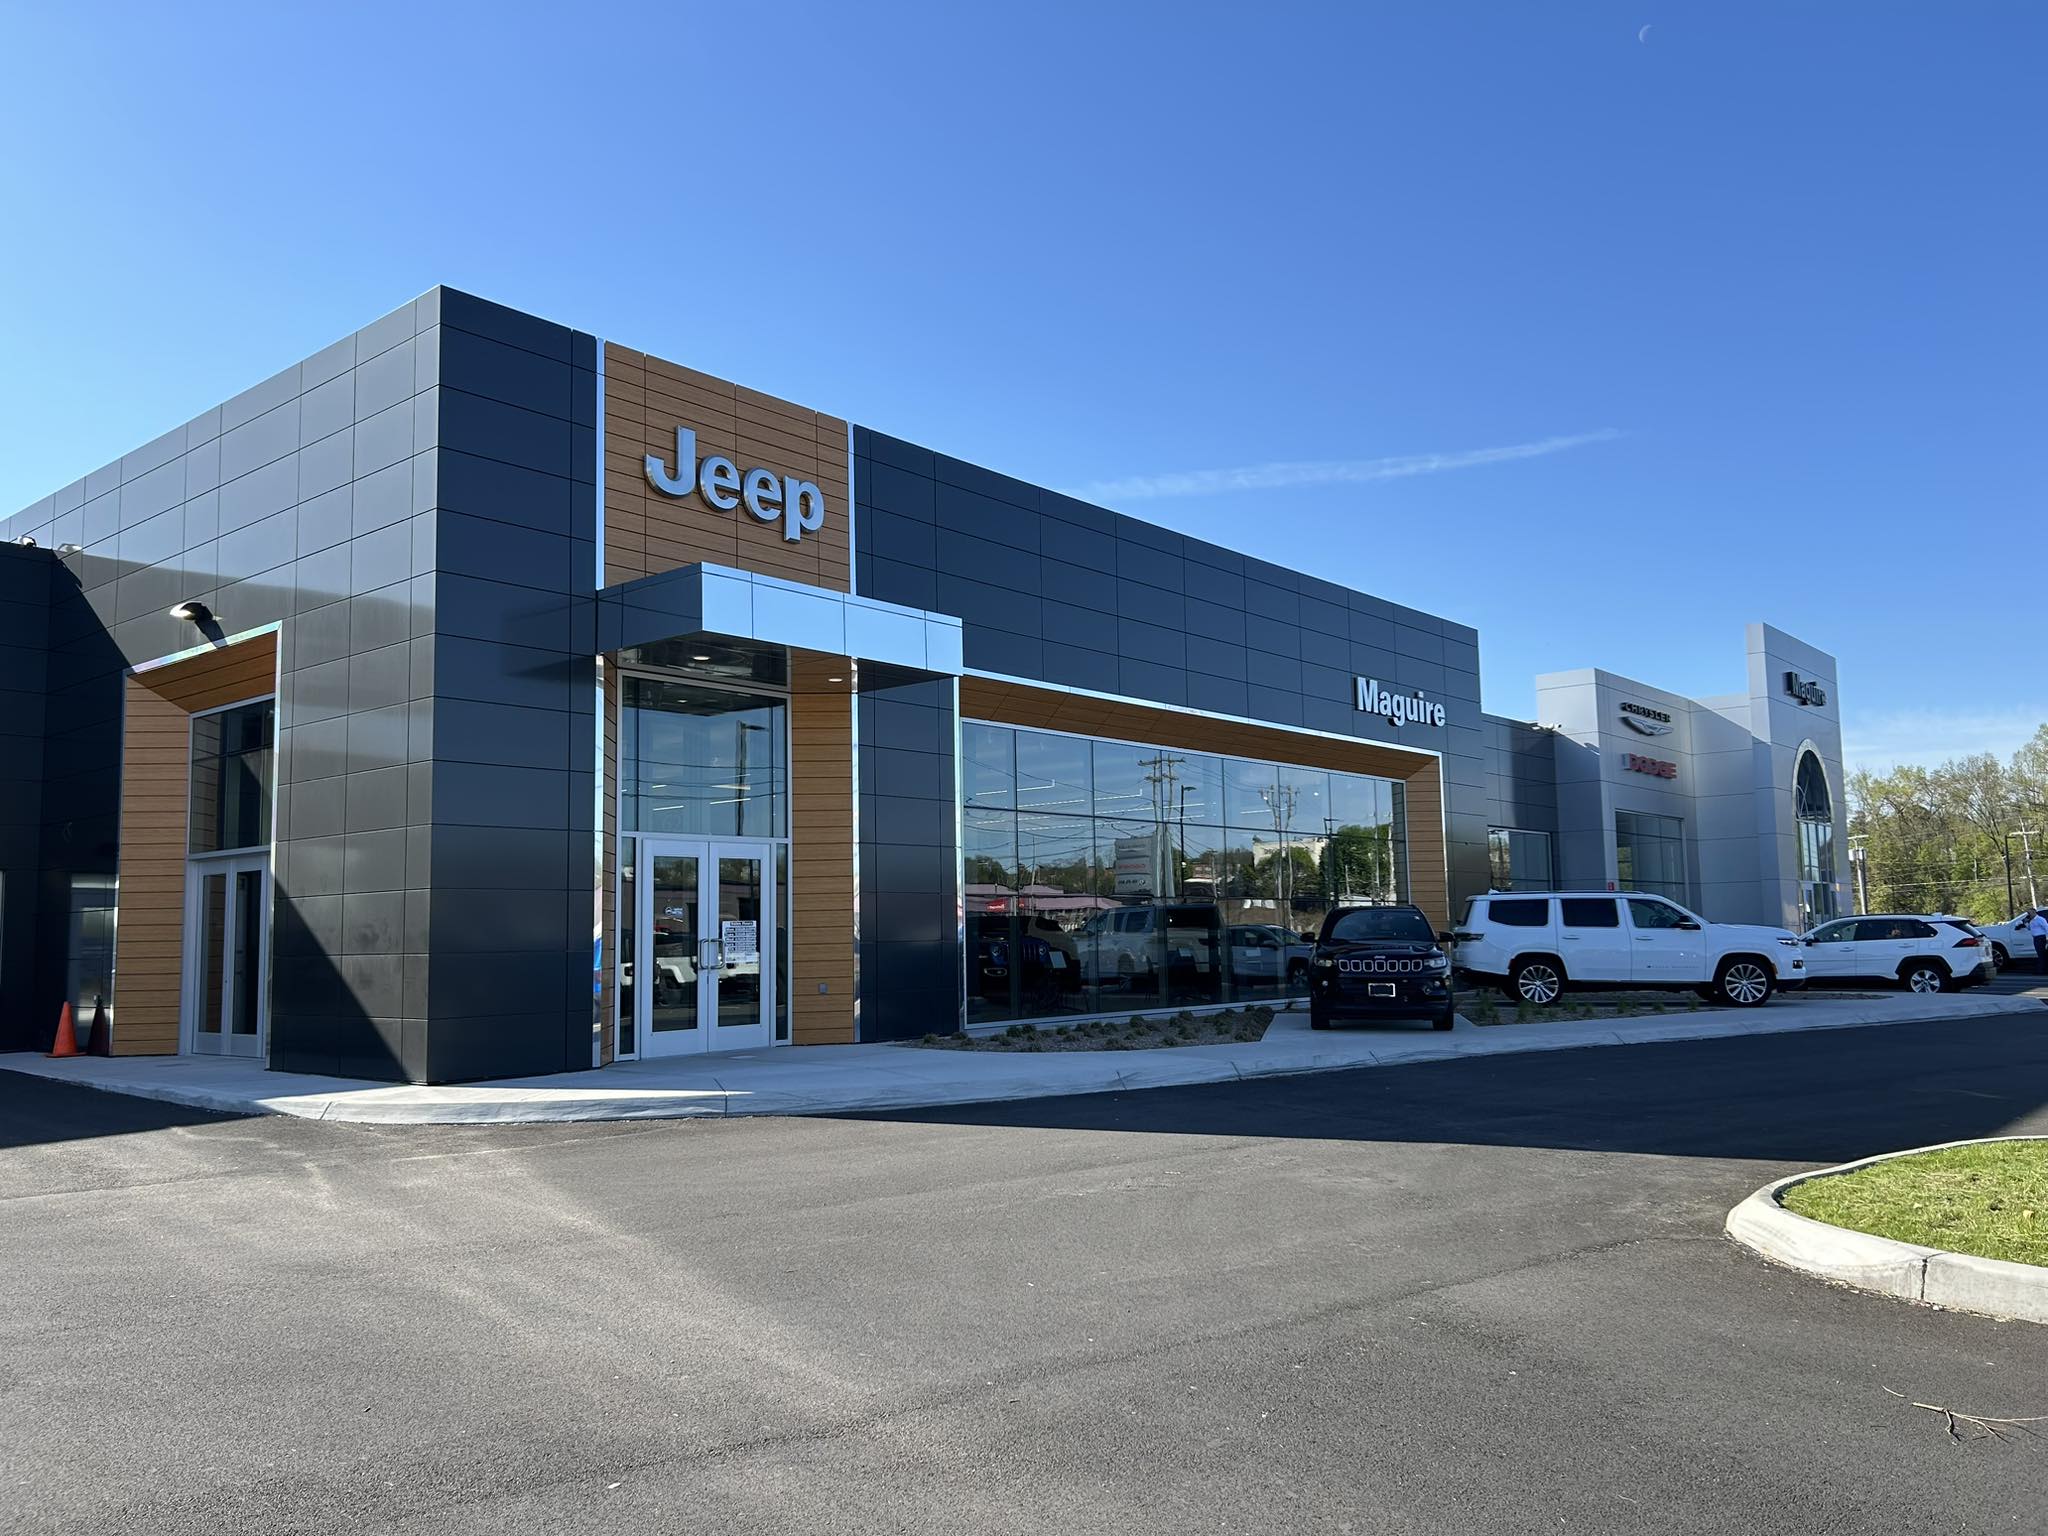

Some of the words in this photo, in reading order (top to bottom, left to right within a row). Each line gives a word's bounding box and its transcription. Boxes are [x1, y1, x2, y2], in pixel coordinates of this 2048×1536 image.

[644, 424, 825, 544] Jeep
[1356, 676, 1446, 727] Maguire
[1621, 703, 1671, 723] CHRYSLER
[1623, 753, 1677, 779] DODGE
